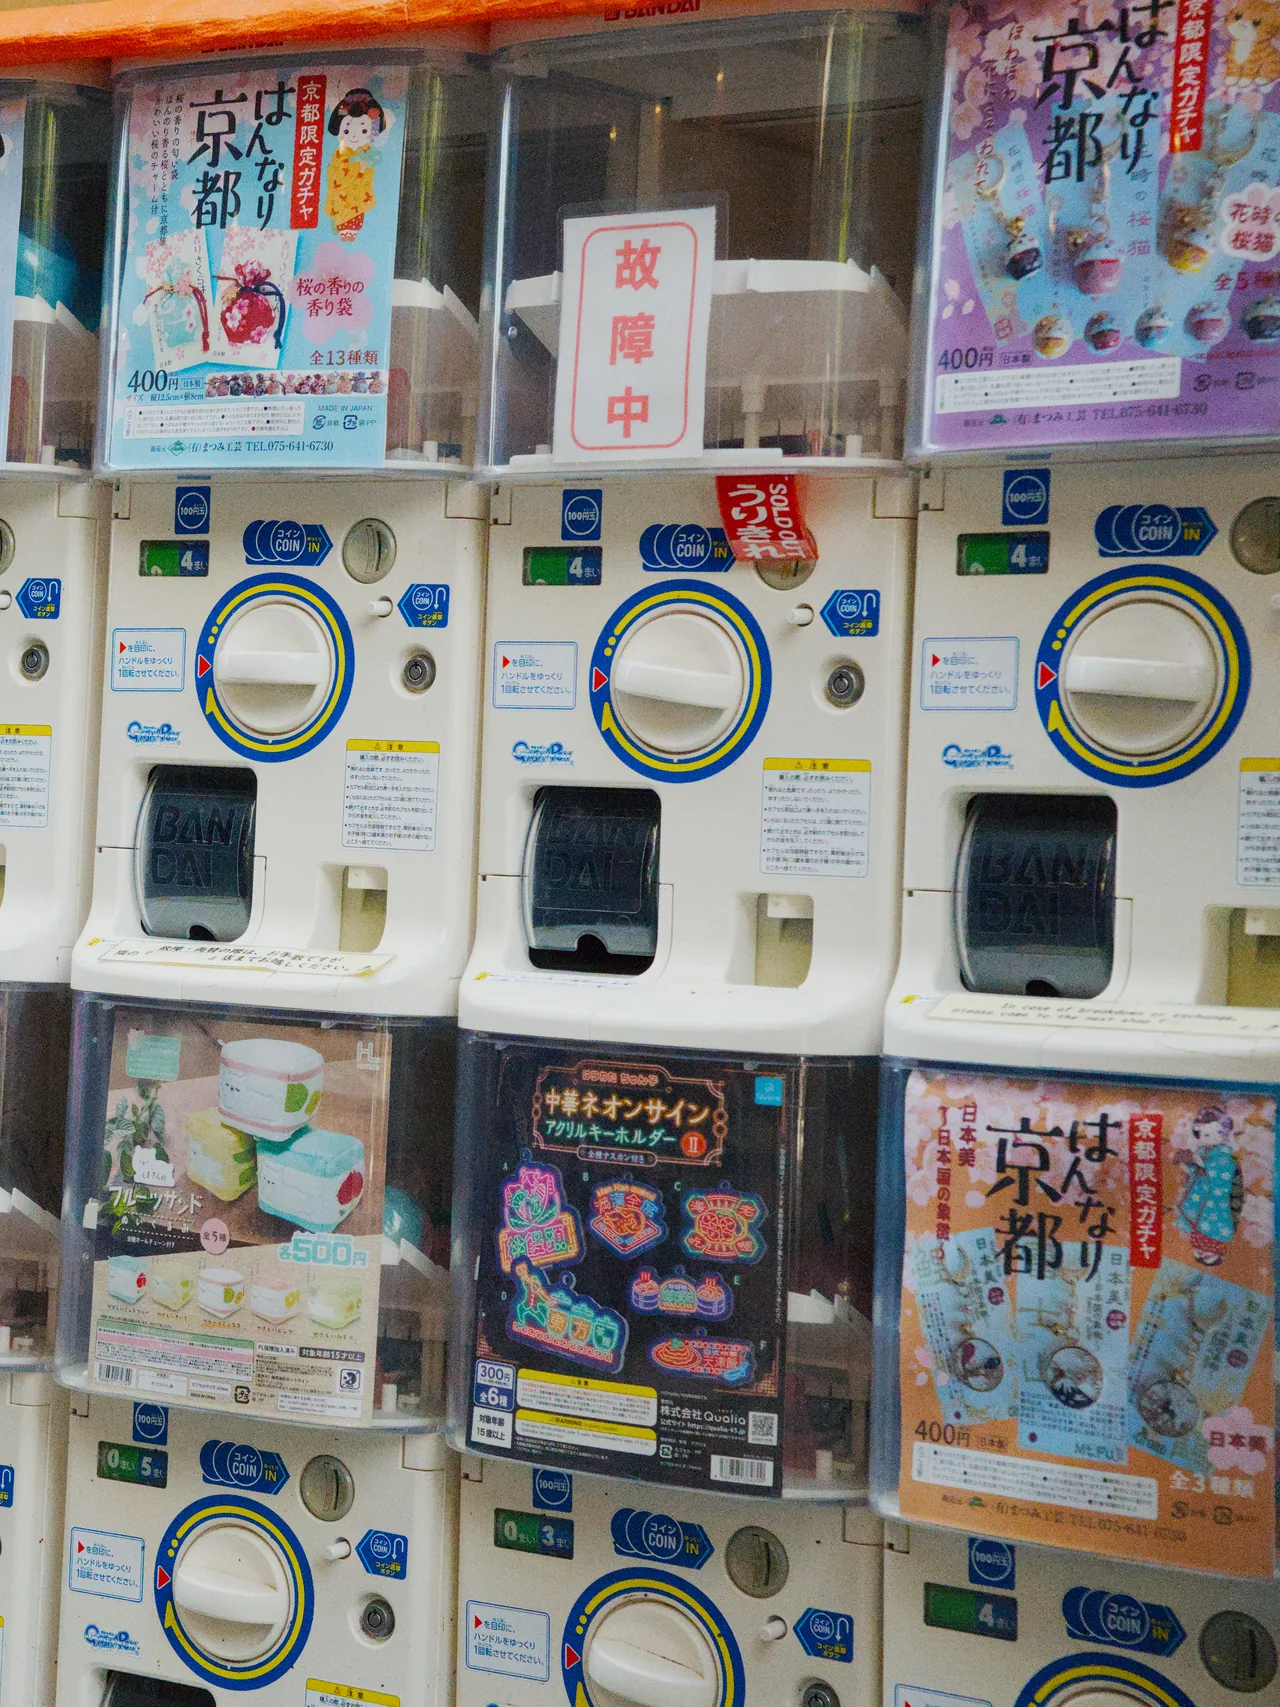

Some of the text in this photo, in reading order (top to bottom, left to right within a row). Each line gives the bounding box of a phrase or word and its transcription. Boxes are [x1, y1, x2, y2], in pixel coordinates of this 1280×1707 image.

[1173, 0, 1210, 143] 京都限定ガチャ
[1107, 0, 1174, 175] はんなり
[1032, 17, 1119, 185] 京都
[170, 92, 185, 181] 桜の香りの匂い袋
[186, 89, 249, 229] 京都
[245, 81, 297, 232] はんなり
[297, 80, 323, 221] 京都限定ガチャ
[295, 276, 365, 296] 桜の香りの
[306, 297, 354, 317] 香り袋
[606, 237, 661, 439] 故障中
[309, 350, 379, 366] 全13種類
[938, 347, 994, 370] 400円
[127, 369, 179, 393] 400円
[318, 404, 339, 412] MADE
[349, 404, 374, 412] JAPAN
[188, 440, 334, 453] (有)まつみ工芸 TEL.075-641-6730
[180, 506, 206, 517] 100円玉
[567, 510, 596, 522] 100円玉
[727, 483, 787, 559] うりきれ
[769, 483, 806, 559] SOLD OUT
[1137, 525, 1174, 543] COIN
[275, 537, 301, 553] COIN
[676, 542, 706, 558] COIN
[1010, 543, 1027, 569] 4
[118, 656, 174, 666] ハンドルをゆっくり
[118, 667, 181, 679] 1回転させてください。
[500, 670, 564, 682] ハンドルをゆっくり
[930, 668, 1004, 682] ハンドルをゆっくり
[500, 682, 573, 696] 1回転させてください。
[928, 682, 1015, 698] 1回転させてください。
[151, 805, 237, 847] BAN
[1022, 1004, 1042, 1012] case
[1078, 1006, 1144, 1017] breakdown
[544, 1087, 710, 1127] 中華ネオンサイン
[545, 1119, 677, 1147] アクリルキーホルダー
[957, 1102, 978, 1168] 日本美
[985, 1117, 1067, 1280] 京都
[1061, 1112, 1123, 1283] はんなり
[1131, 1117, 1161, 1261] 京都限定ガチャ
[109, 1185, 203, 1216] フルーツサンド
[202, 1232, 227, 1243] 全5種
[279, 1236, 368, 1268] 各500円
[301, 1348, 364, 1362] 対象年齢15才以上
[479, 1367, 511, 1383] 300円
[479, 1387, 509, 1407] 全6種
[137, 1414, 164, 1428] 100円玉
[479, 1415, 505, 1428] 対象年齢
[661, 1405, 746, 1426] 株式会社 Qualia
[476, 1427, 506, 1441] 15歳以上
[914, 1419, 971, 1447] 400円
[141, 1456, 154, 1477] 5
[232, 1461, 258, 1479] COIN
[538, 1478, 568, 1493] 100円玉
[1170, 1471, 1255, 1500] 全3種類
[503, 1519, 517, 1539] 0
[541, 1523, 555, 1547] 3
[647, 1531, 677, 1551] COIN
[76, 1556, 133, 1574] ハンドルをゆっくり
[76, 1567, 139, 1589] 1回転させてください。
[978, 1603, 994, 1628] 4
[1106, 1614, 1143, 1635] COIN
[473, 1631, 536, 1650] ハンドルをゆっくり
[473, 1643, 545, 1667] 1回転させてください。
